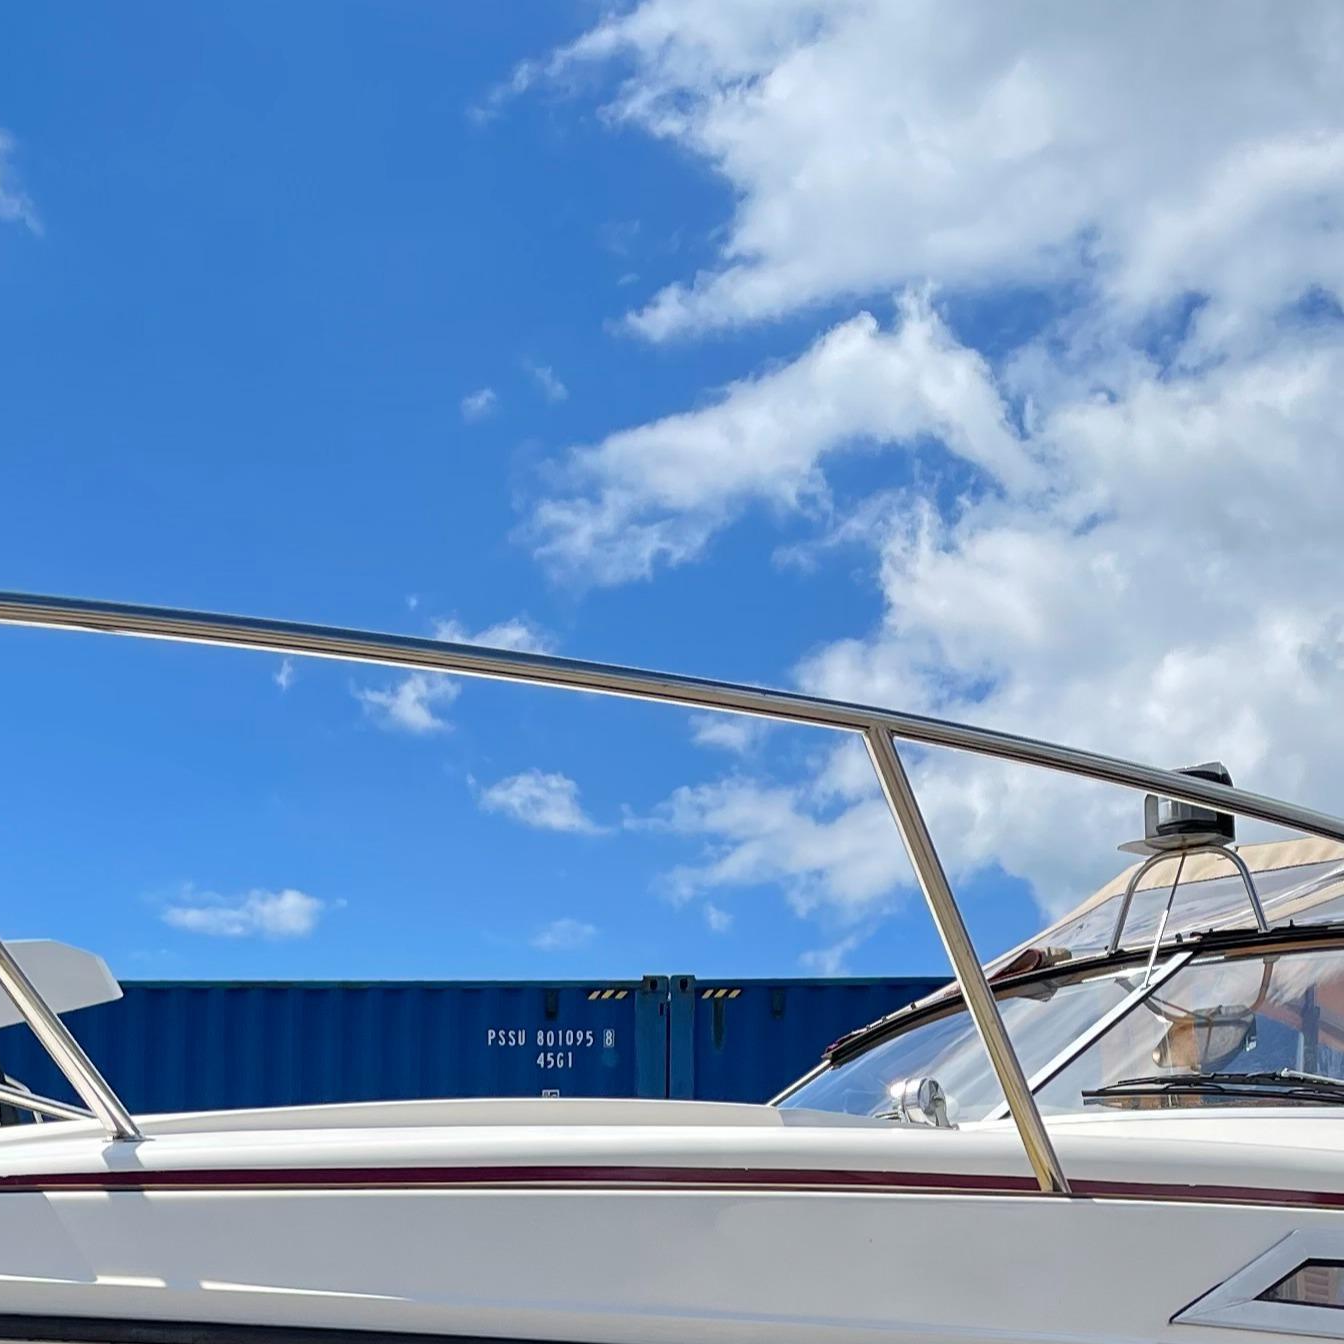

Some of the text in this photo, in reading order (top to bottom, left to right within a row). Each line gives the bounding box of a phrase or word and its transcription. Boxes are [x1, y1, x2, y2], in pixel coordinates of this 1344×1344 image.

[487, 1028, 615, 1048] PSSU 801095 8
[536, 1051, 573, 1069] 45G1
